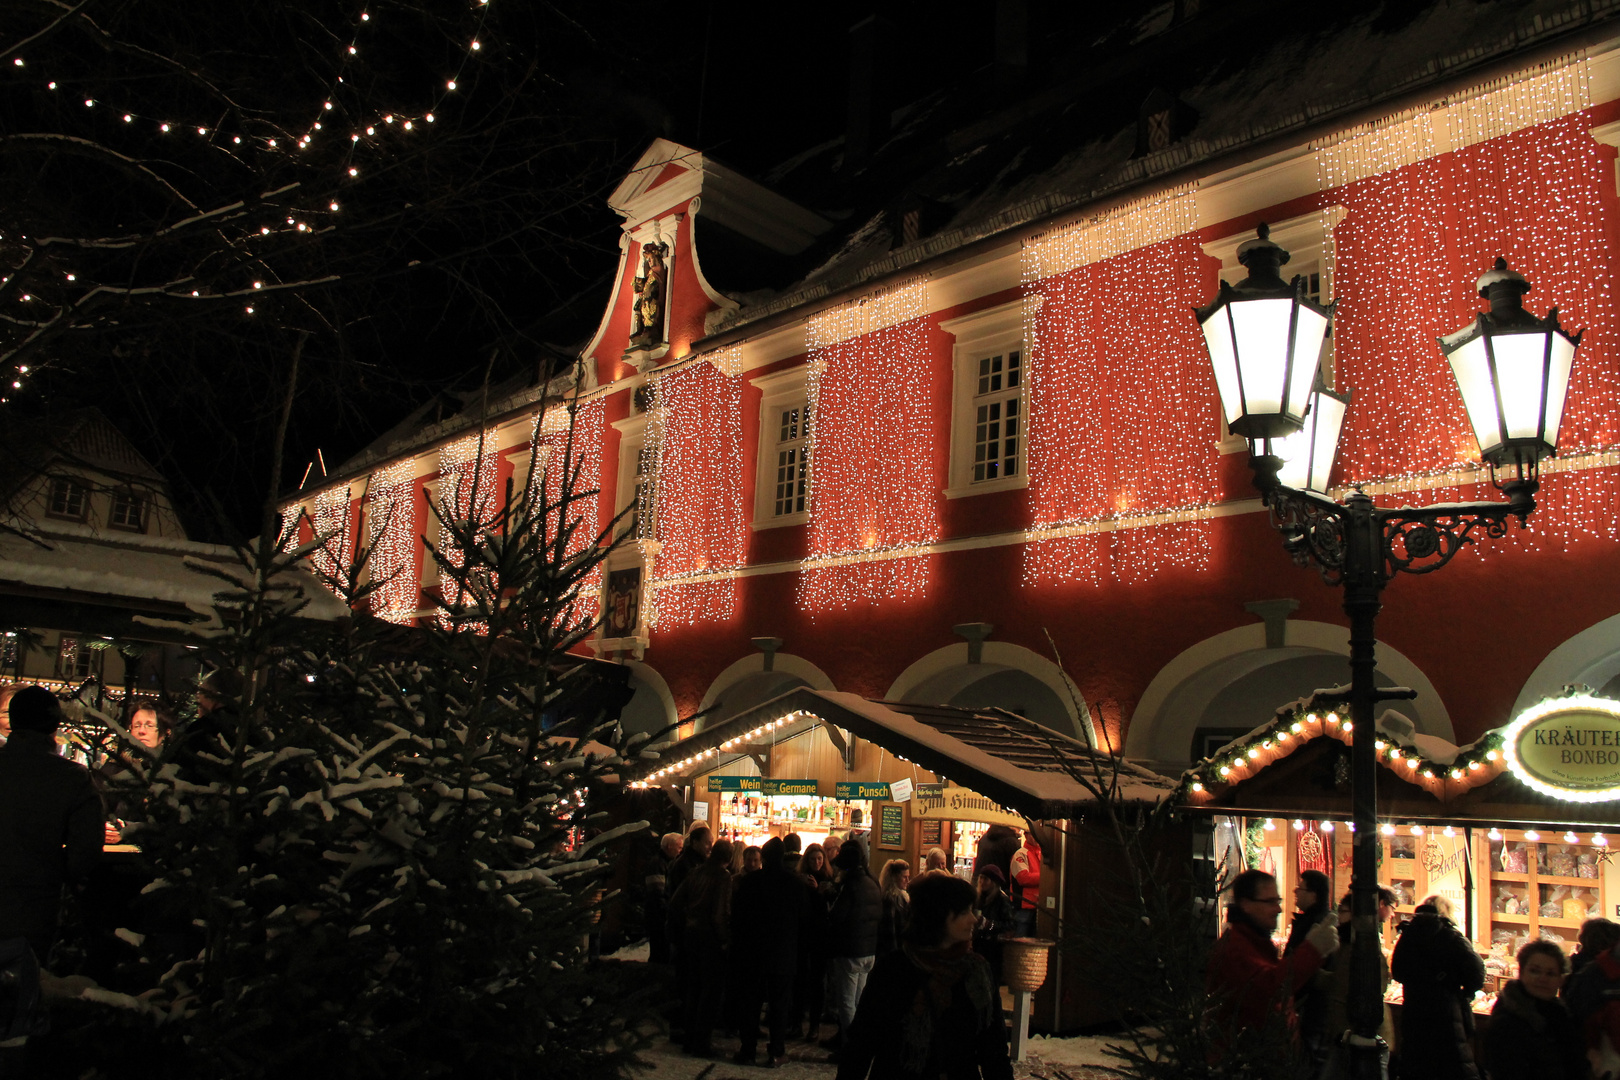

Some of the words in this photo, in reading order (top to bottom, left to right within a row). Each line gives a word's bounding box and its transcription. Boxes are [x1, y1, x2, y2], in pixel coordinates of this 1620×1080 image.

[1551, 769, 1566, 778] ohne
[1566, 773, 1594, 782] künstliche
[740, 779, 761, 790] Wein
[779, 782, 816, 794] Germane
[858, 785, 889, 798] Punsch
